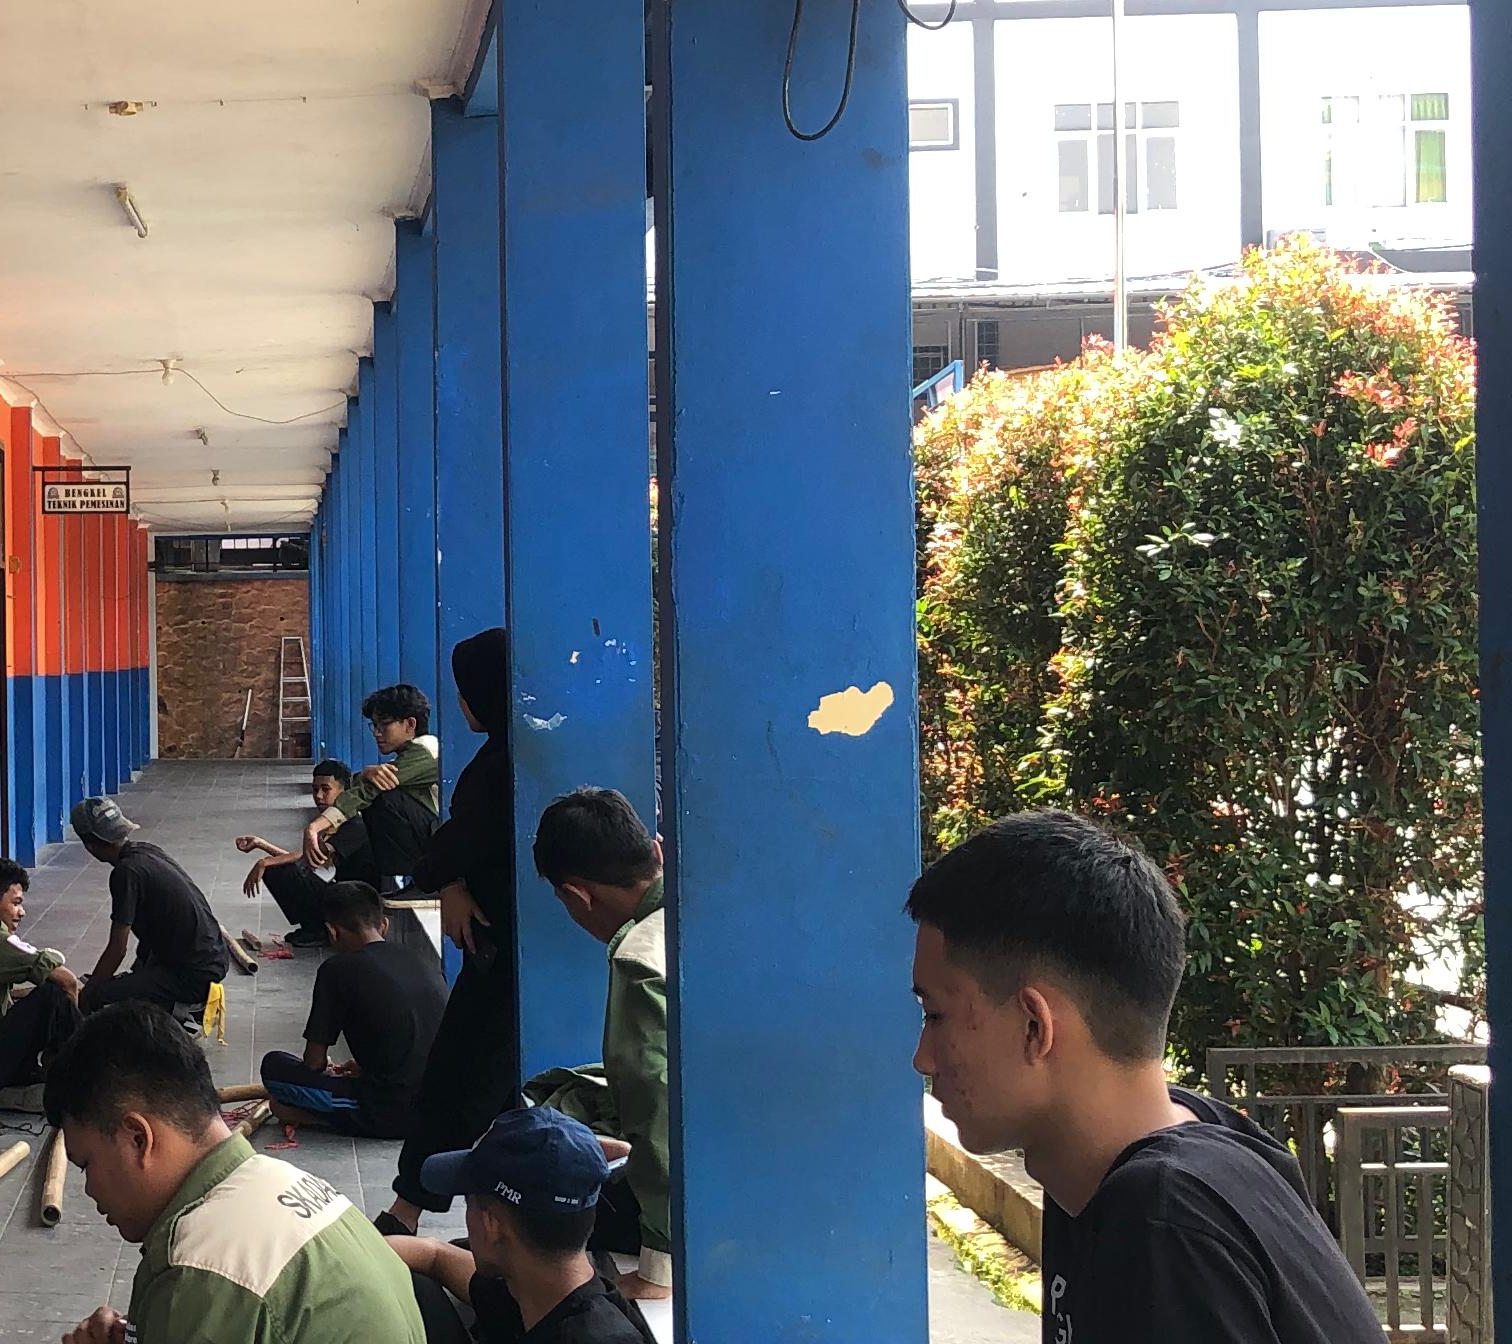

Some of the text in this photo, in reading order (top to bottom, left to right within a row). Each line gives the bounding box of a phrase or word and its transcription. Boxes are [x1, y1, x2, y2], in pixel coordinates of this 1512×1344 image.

[64, 488, 107, 498] BENGKEL
[47, 499, 125, 509] TEKNIK PEMESINAN
[493, 1180, 523, 1205] PMR
